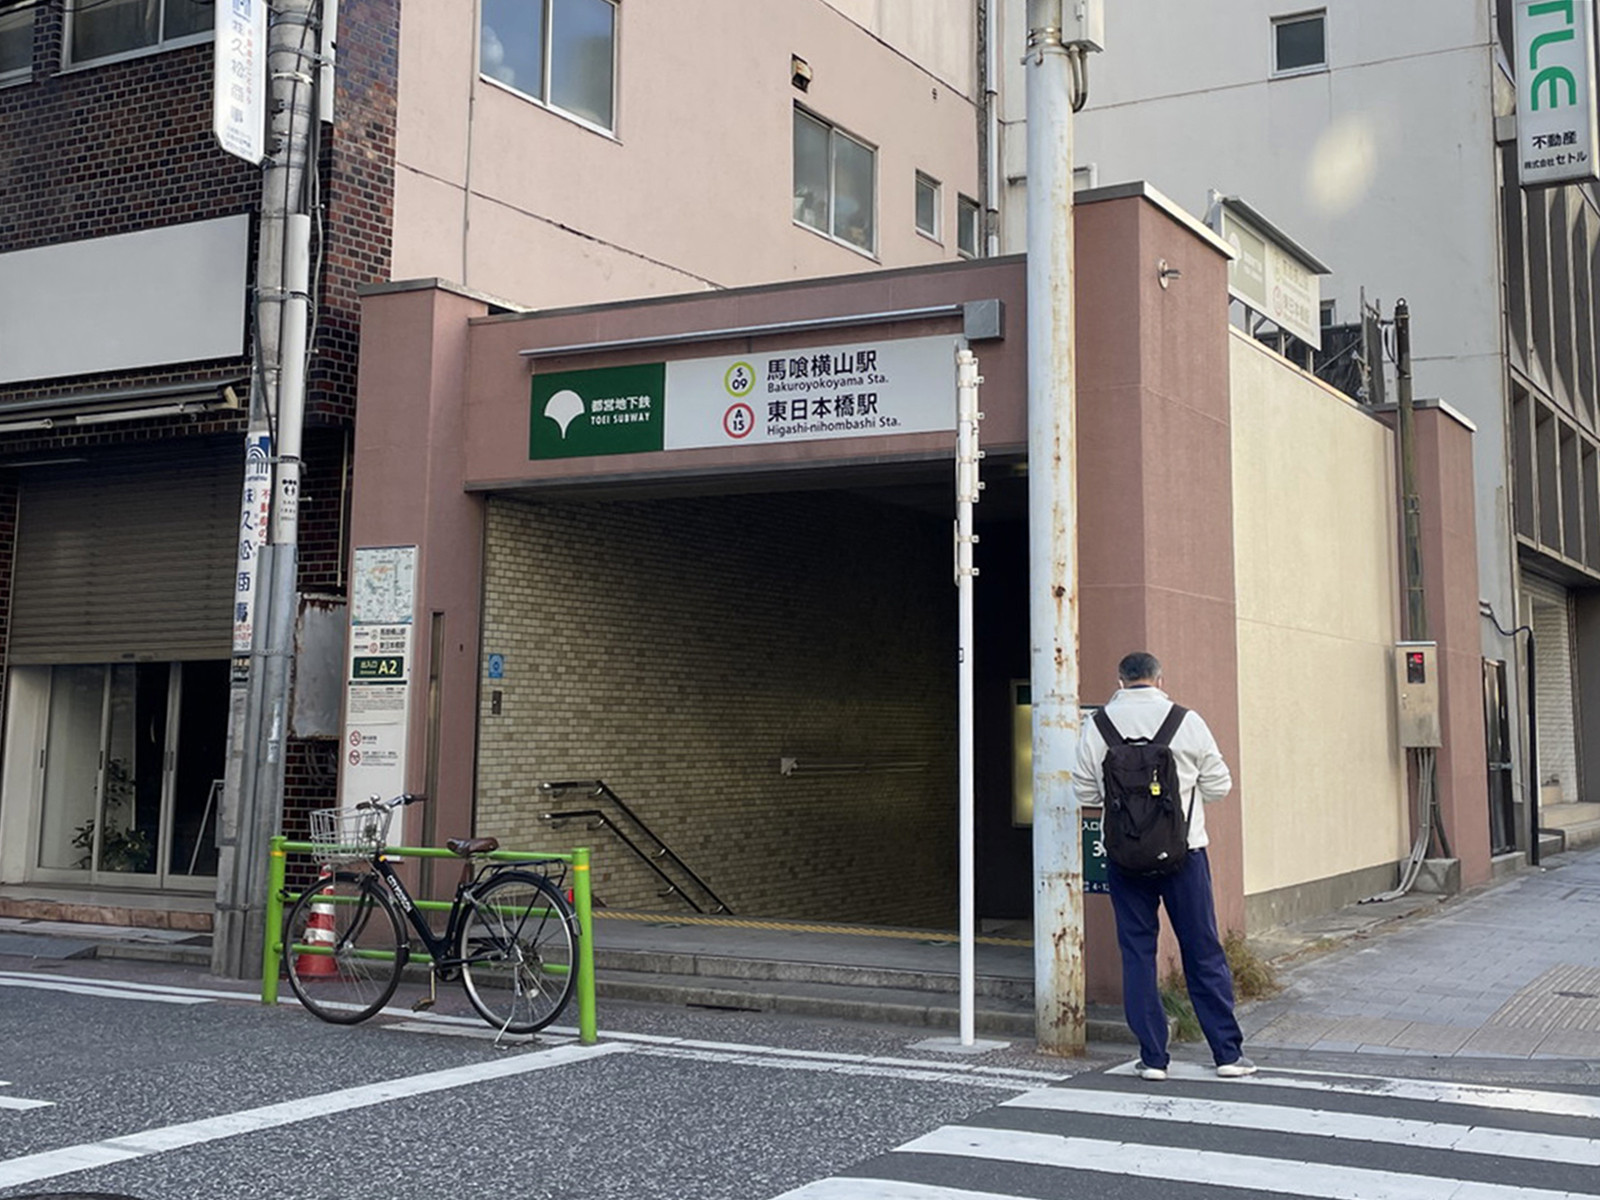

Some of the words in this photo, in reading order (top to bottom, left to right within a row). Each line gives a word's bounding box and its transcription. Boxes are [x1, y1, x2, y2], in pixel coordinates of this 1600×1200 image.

[1532, 131, 1577, 149] 不動産
[1524, 151, 1587, 170] 株式会社セトル
[736, 367, 743, 378] S
[767, 350, 877, 381] 馬喰横山駅
[732, 378, 748, 391] 09
[767, 377, 864, 393] Bakuroyokoyama
[867, 373, 889, 385] Sta.
[591, 395, 651, 412] 都営地下鉄
[767, 393, 878, 422] 東日本橋駅
[591, 415, 610, 425] TOEI
[613, 412, 650, 424] SUBWAY
[735, 409, 743, 419] A
[732, 420, 745, 431] 15
[767, 417, 876, 437] Higashi-nihombashi
[879, 415, 902, 428] Sta.
[378, 660, 397, 675] A2
